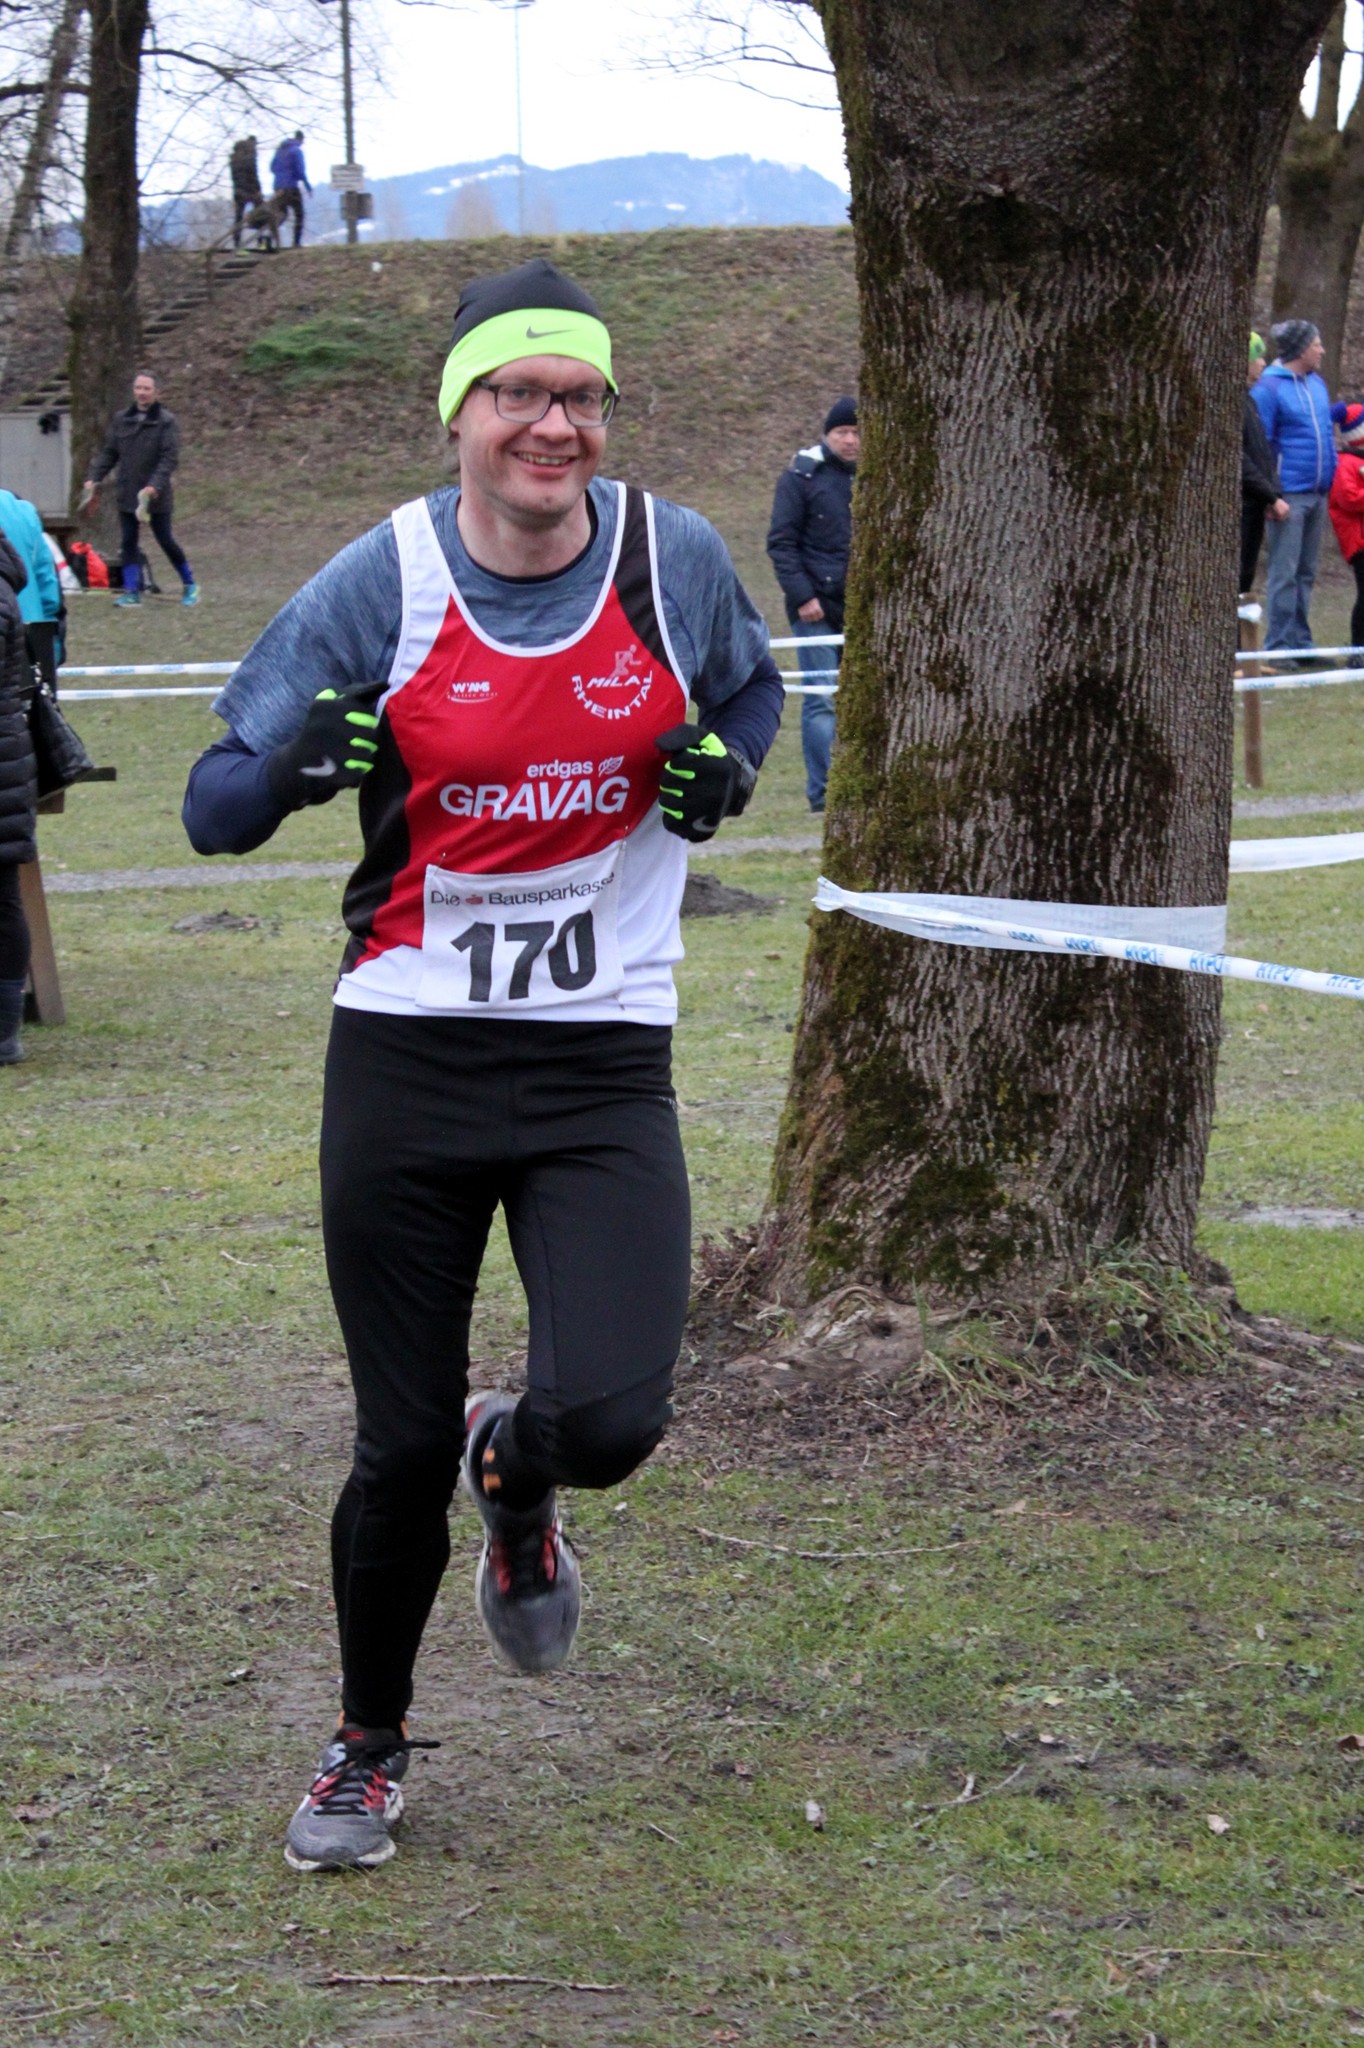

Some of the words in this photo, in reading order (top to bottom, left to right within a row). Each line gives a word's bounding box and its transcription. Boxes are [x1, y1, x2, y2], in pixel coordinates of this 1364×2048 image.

[571, 670, 653, 720] RHEINTAL
[586, 675, 641, 689] MILA
[527, 759, 593, 779] erdgas
[439, 776, 630, 822] GRAVAG
[430, 890, 461, 906] Die
[450, 909, 597, 1003] 170
